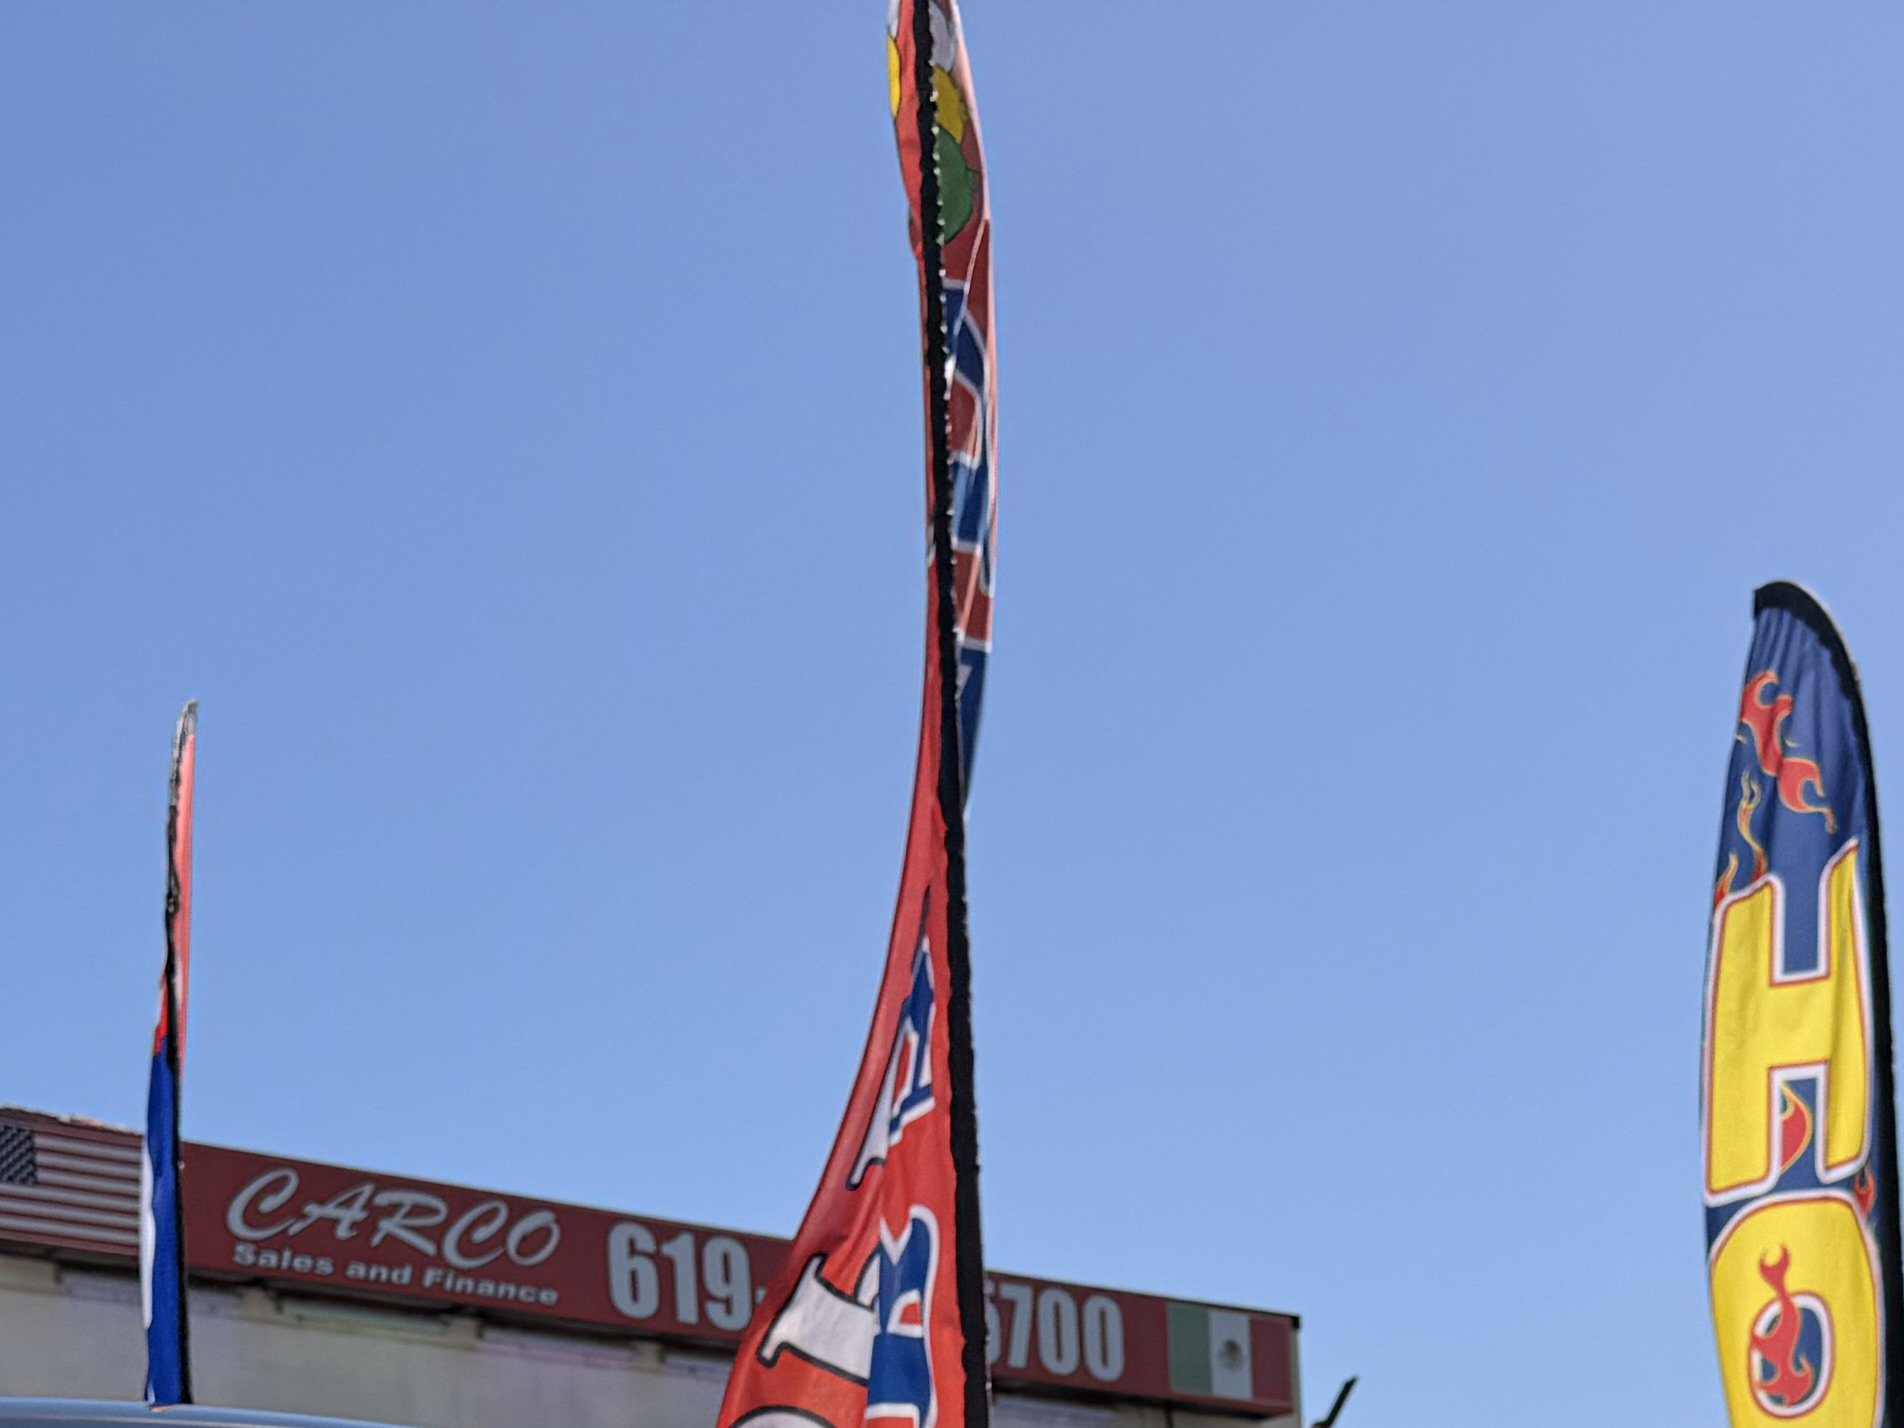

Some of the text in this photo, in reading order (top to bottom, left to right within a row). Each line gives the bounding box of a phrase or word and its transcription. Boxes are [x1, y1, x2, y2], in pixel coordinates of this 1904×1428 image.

[225, 1167, 561, 1269] CARCO
[232, 1241, 560, 1307] Sales and Finance
